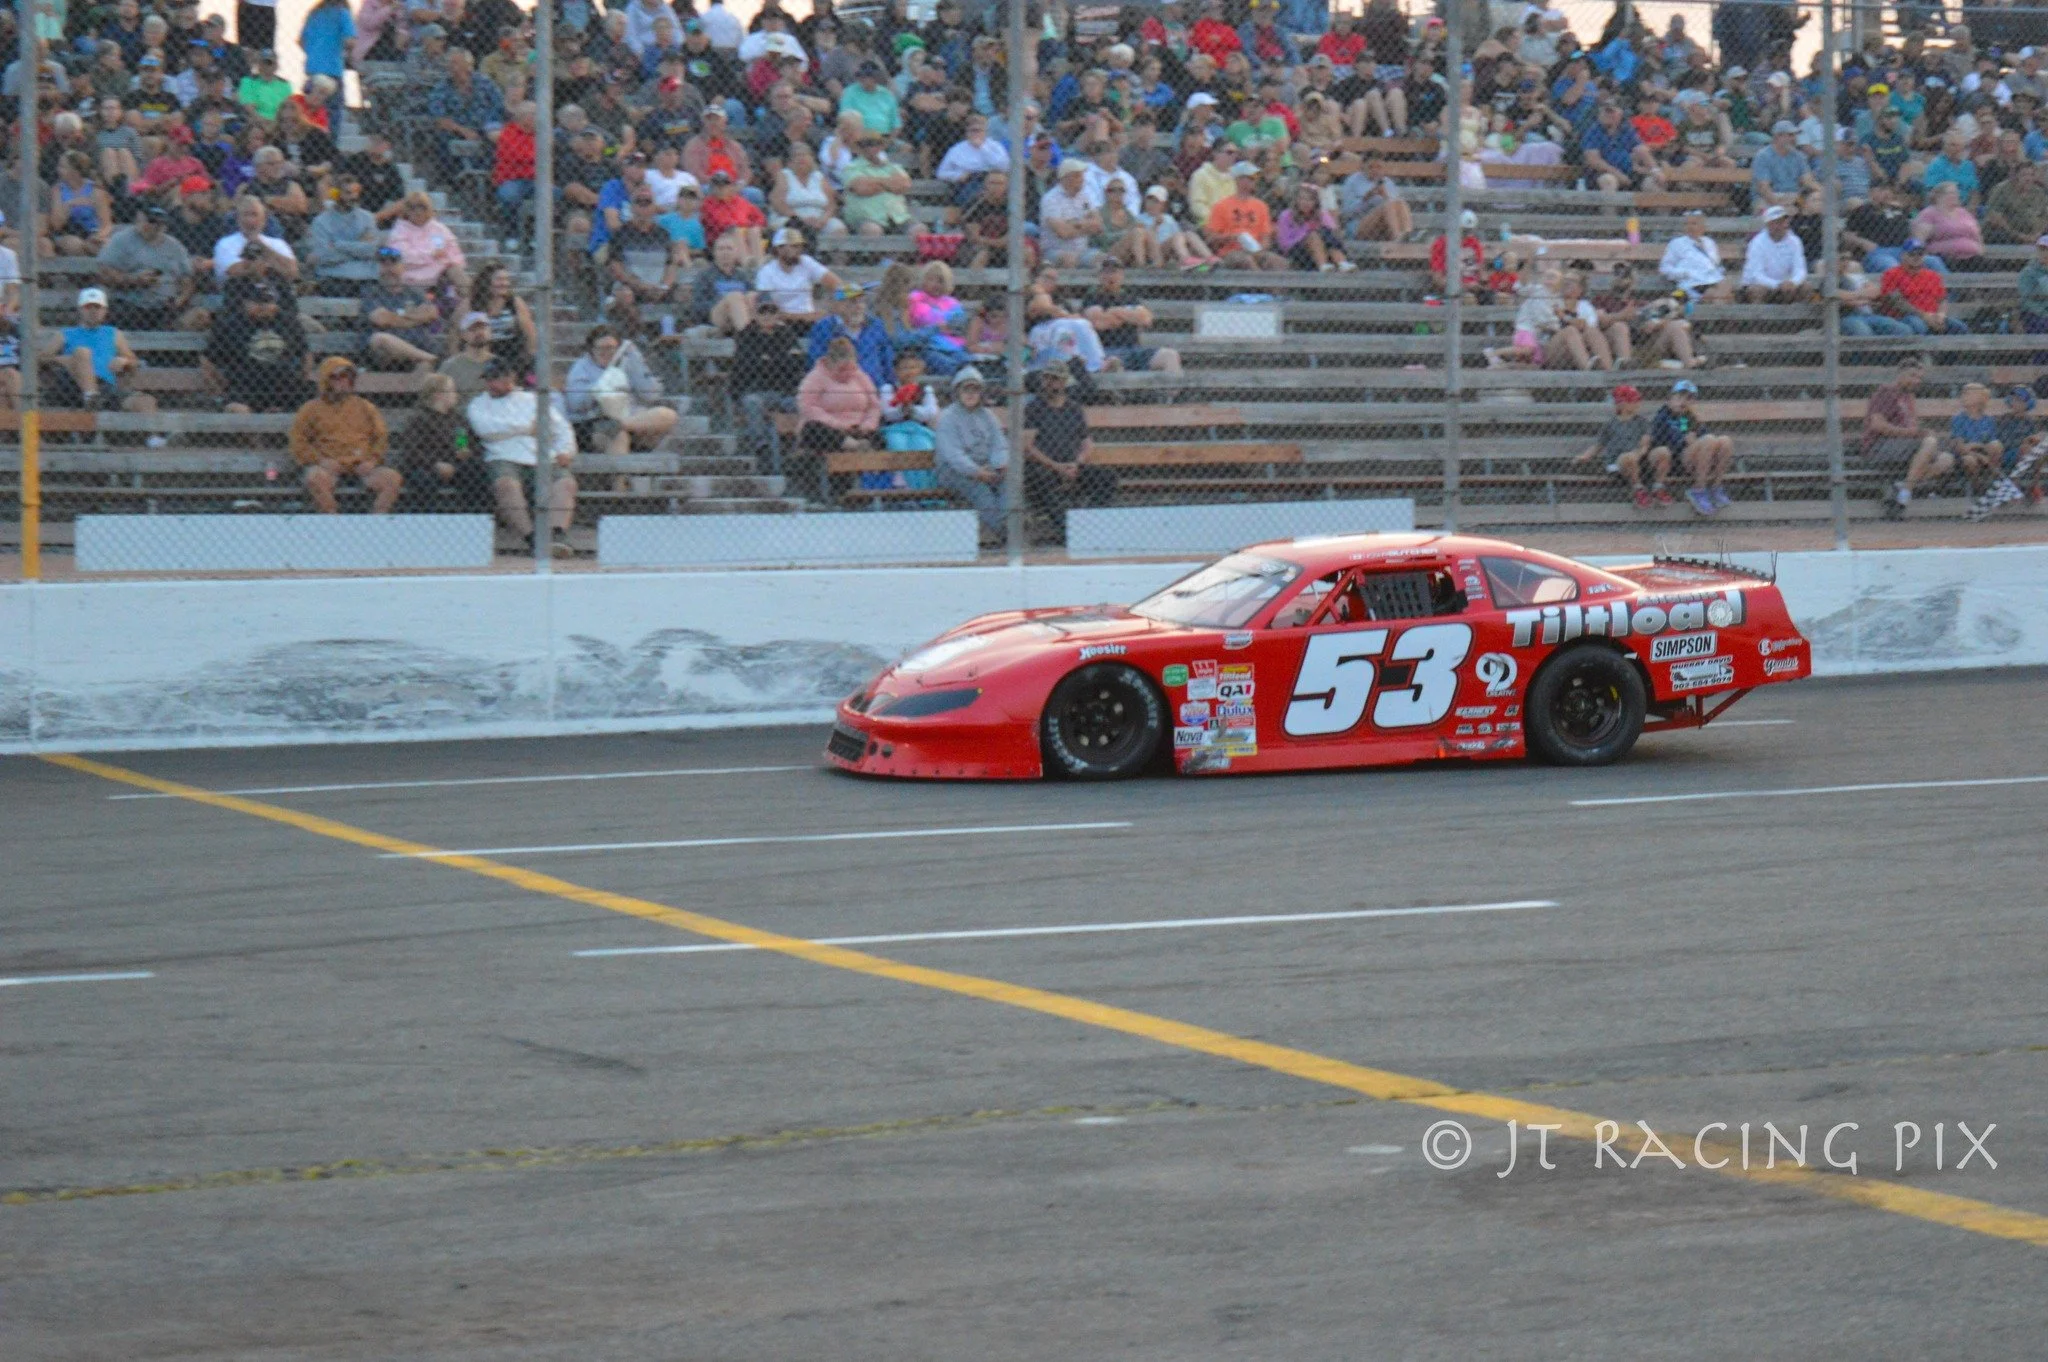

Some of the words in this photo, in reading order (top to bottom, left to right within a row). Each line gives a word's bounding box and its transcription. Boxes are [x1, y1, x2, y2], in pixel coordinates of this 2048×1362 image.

[1080, 643, 1127, 660] Hoosier
[1654, 635, 1712, 658] SIMPSON
[1671, 660, 1705, 670] MURRAY
[1707, 656, 1732, 665] DAVIS
[1283, 622, 1473, 736] 53
[1220, 684, 1252, 698] QA1
[1218, 704, 1253, 716] Dulux
[1176, 730, 1203, 743] Nova
